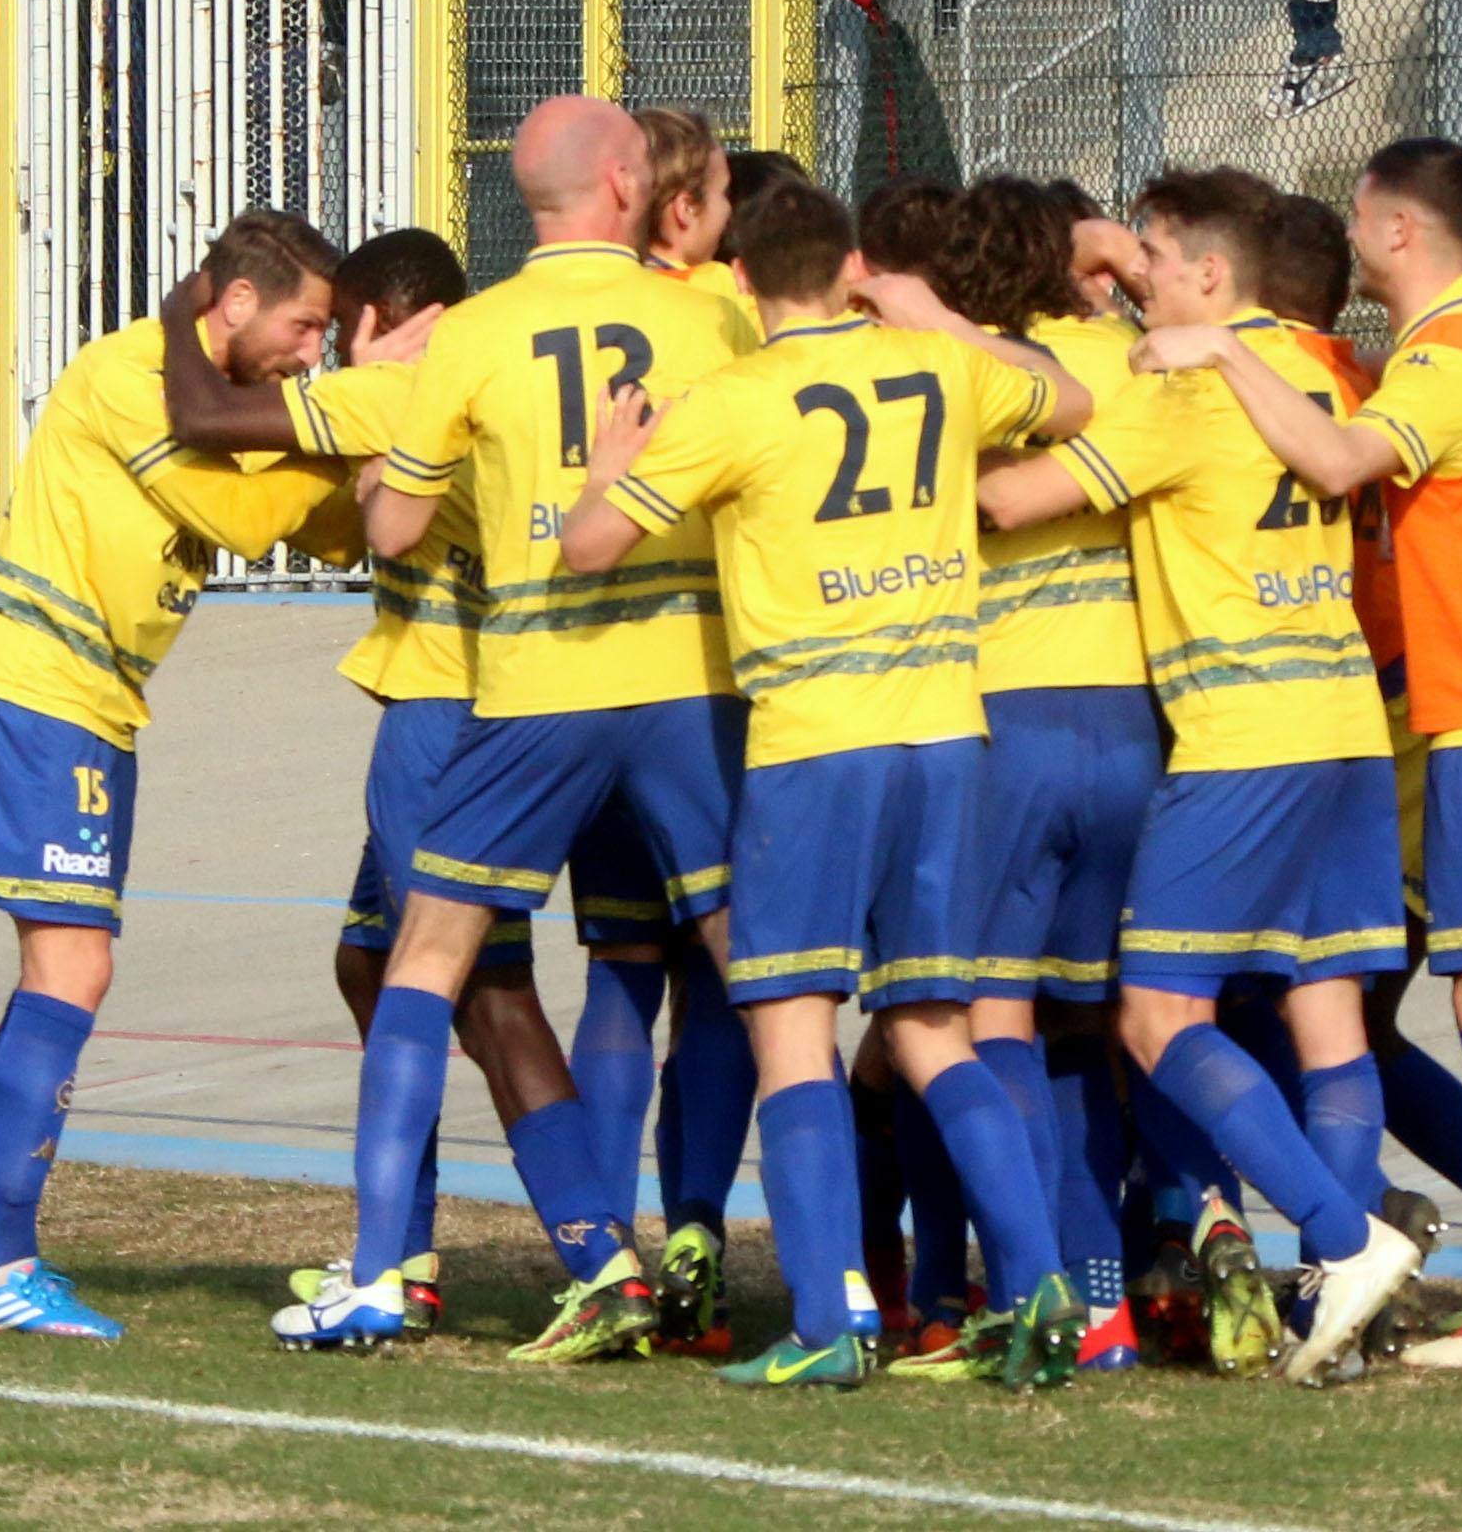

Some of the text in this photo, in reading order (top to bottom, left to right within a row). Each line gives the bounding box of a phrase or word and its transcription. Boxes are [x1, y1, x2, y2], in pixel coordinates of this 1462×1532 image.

[794, 370, 946, 525] 27
[818, 548, 967, 606] BlueRed
[73, 766, 110, 817] 15
